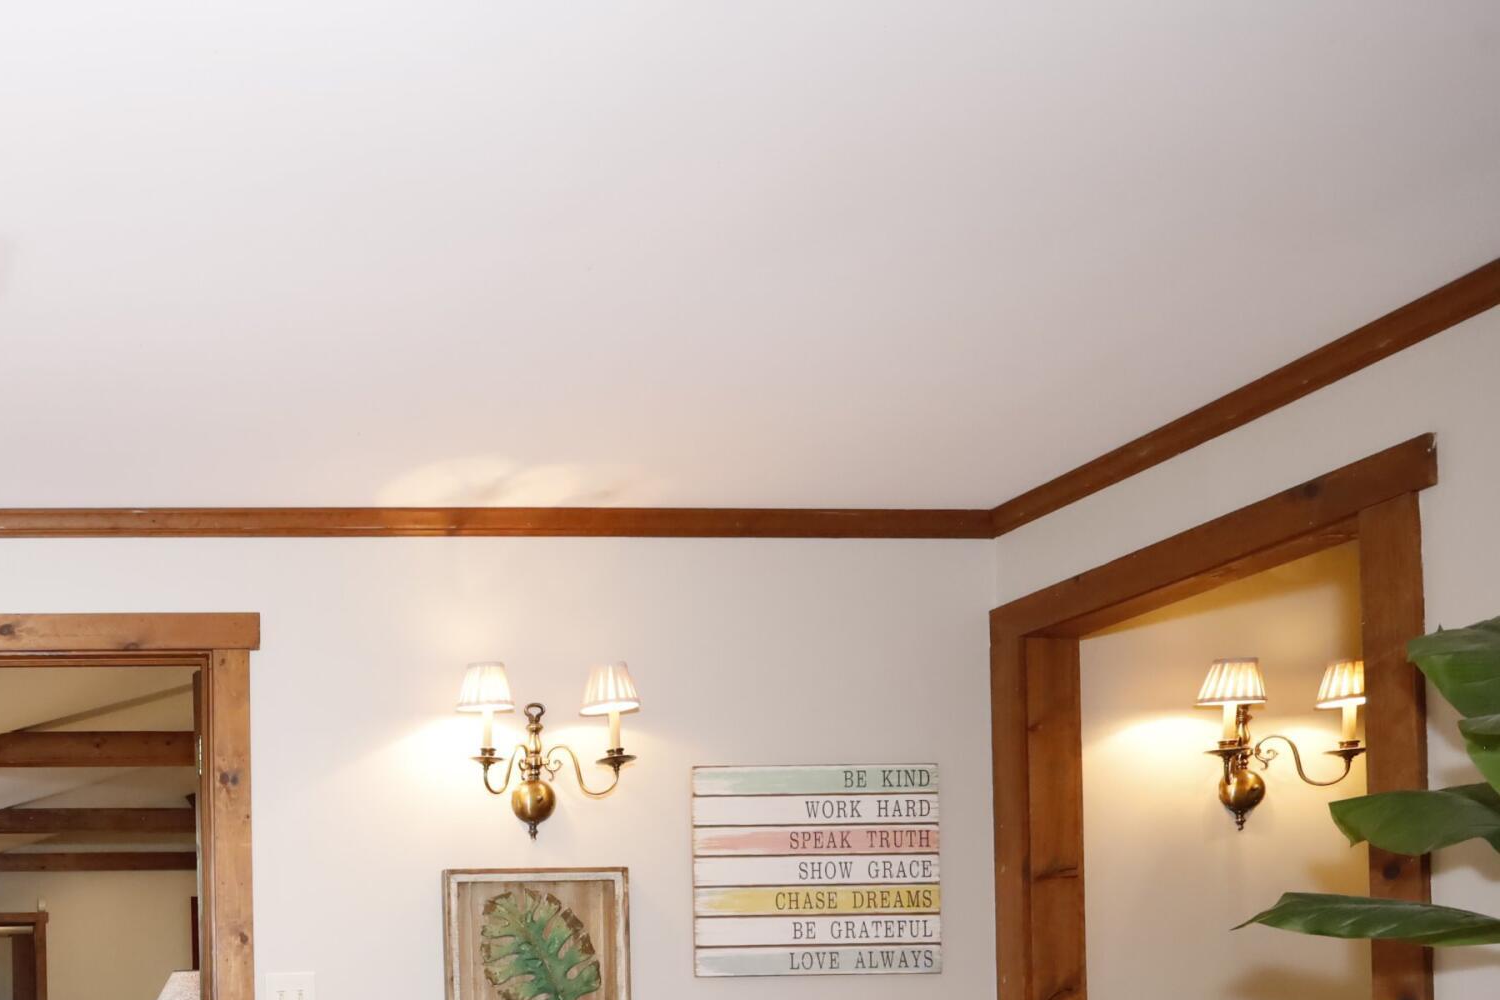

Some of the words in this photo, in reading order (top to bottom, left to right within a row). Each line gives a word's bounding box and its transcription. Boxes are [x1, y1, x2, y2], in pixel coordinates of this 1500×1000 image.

[843, 769, 867, 788] BE
[881, 769, 931, 787] KIND
[805, 800, 862, 818] WORK
[877, 799, 931, 817] HARD
[789, 831, 852, 849] SPEAK
[866, 830, 931, 848] TRUTH
[798, 861, 853, 880] SHOW
[868, 860, 932, 878] GRACE
[775, 891, 838, 910] CHASE
[852, 890, 933, 909] DREAMS
[792, 921, 816, 939] BE
[830, 920, 933, 939] GRATEFUL
[789, 952, 840, 970] LOVE
[855, 950, 934, 969] ALWAYS
